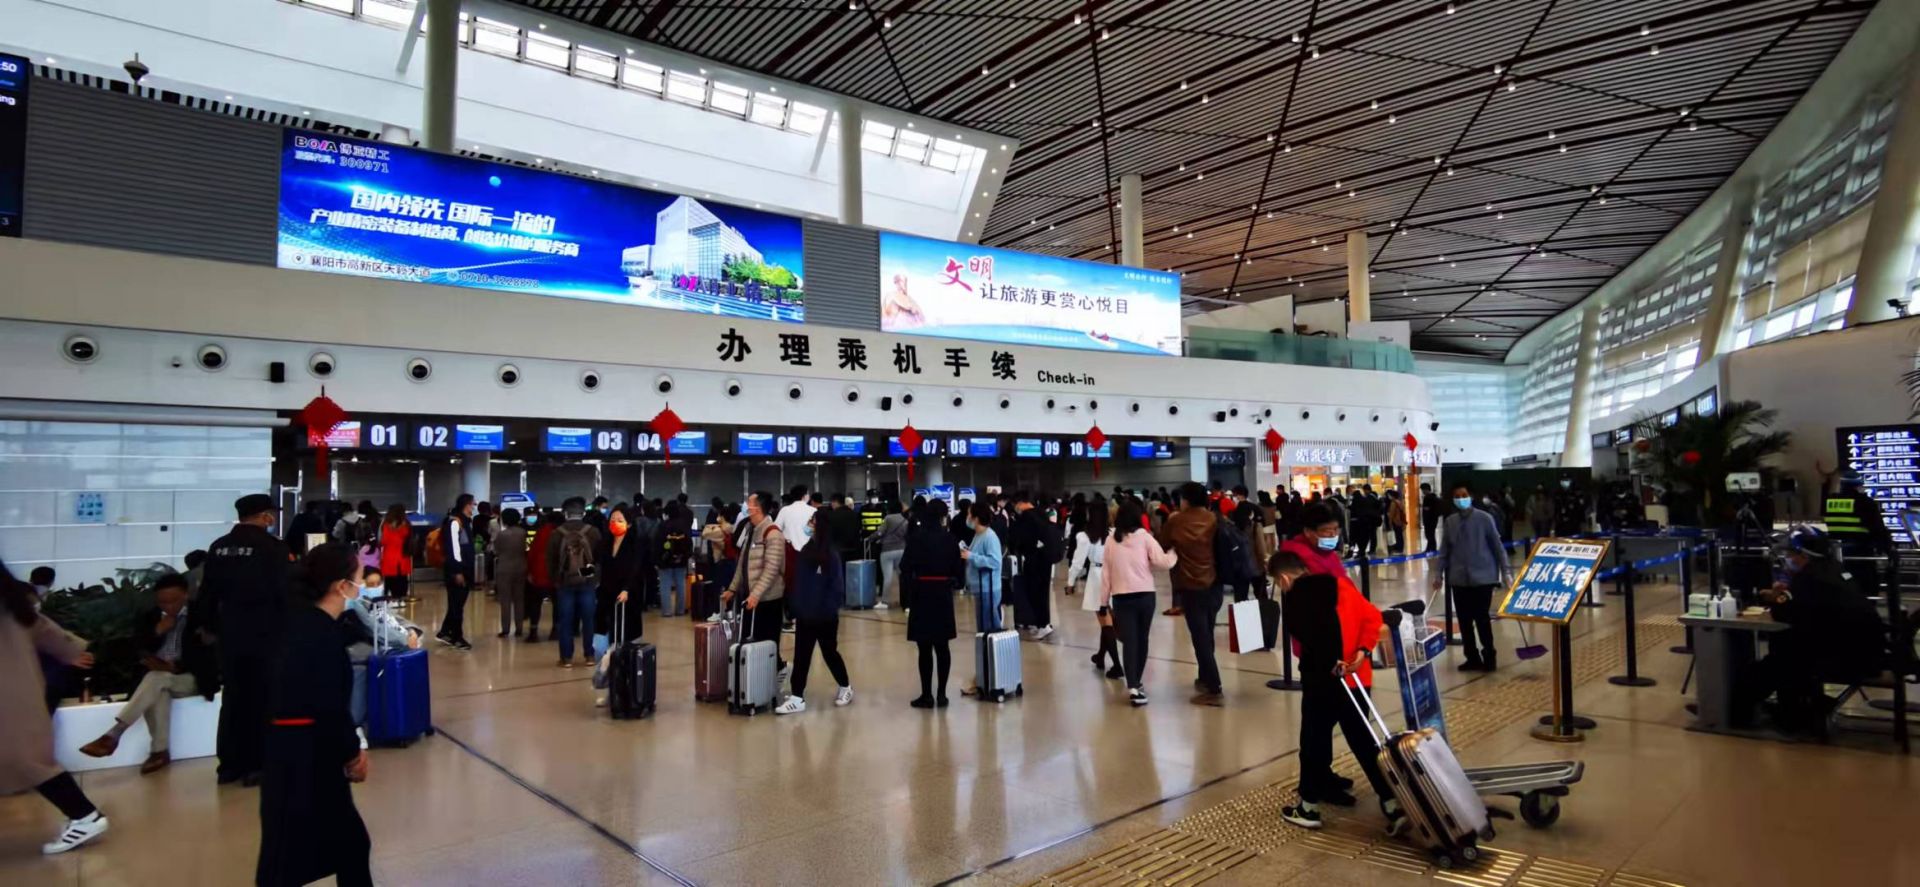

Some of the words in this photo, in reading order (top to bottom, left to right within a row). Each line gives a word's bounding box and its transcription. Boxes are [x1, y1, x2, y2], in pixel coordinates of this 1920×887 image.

[340, 156, 389, 173] 300971
[351, 188, 445, 220] 国内领先
[447, 202, 556, 235] 国际一流的
[938, 258, 993, 293] 文明
[980, 282, 1128, 314] 让旅游更赏心悦目
[716, 328, 1017, 380] 办理乘机手续
[1037, 370, 1095, 386] Check-in
[371, 424, 397, 446] 01
[419, 426, 448, 447] 02
[597, 431, 622, 450] 03
[637, 433, 661, 451] 04
[777, 436, 797, 453] 05
[809, 437, 828, 454] 06
[922, 439, 937, 454] 07
[950, 439, 966, 455] 08
[1044, 441, 1060, 456] 09
[1070, 441, 1083, 456] 10
[1514, 589, 1571, 613] 出航站楼
